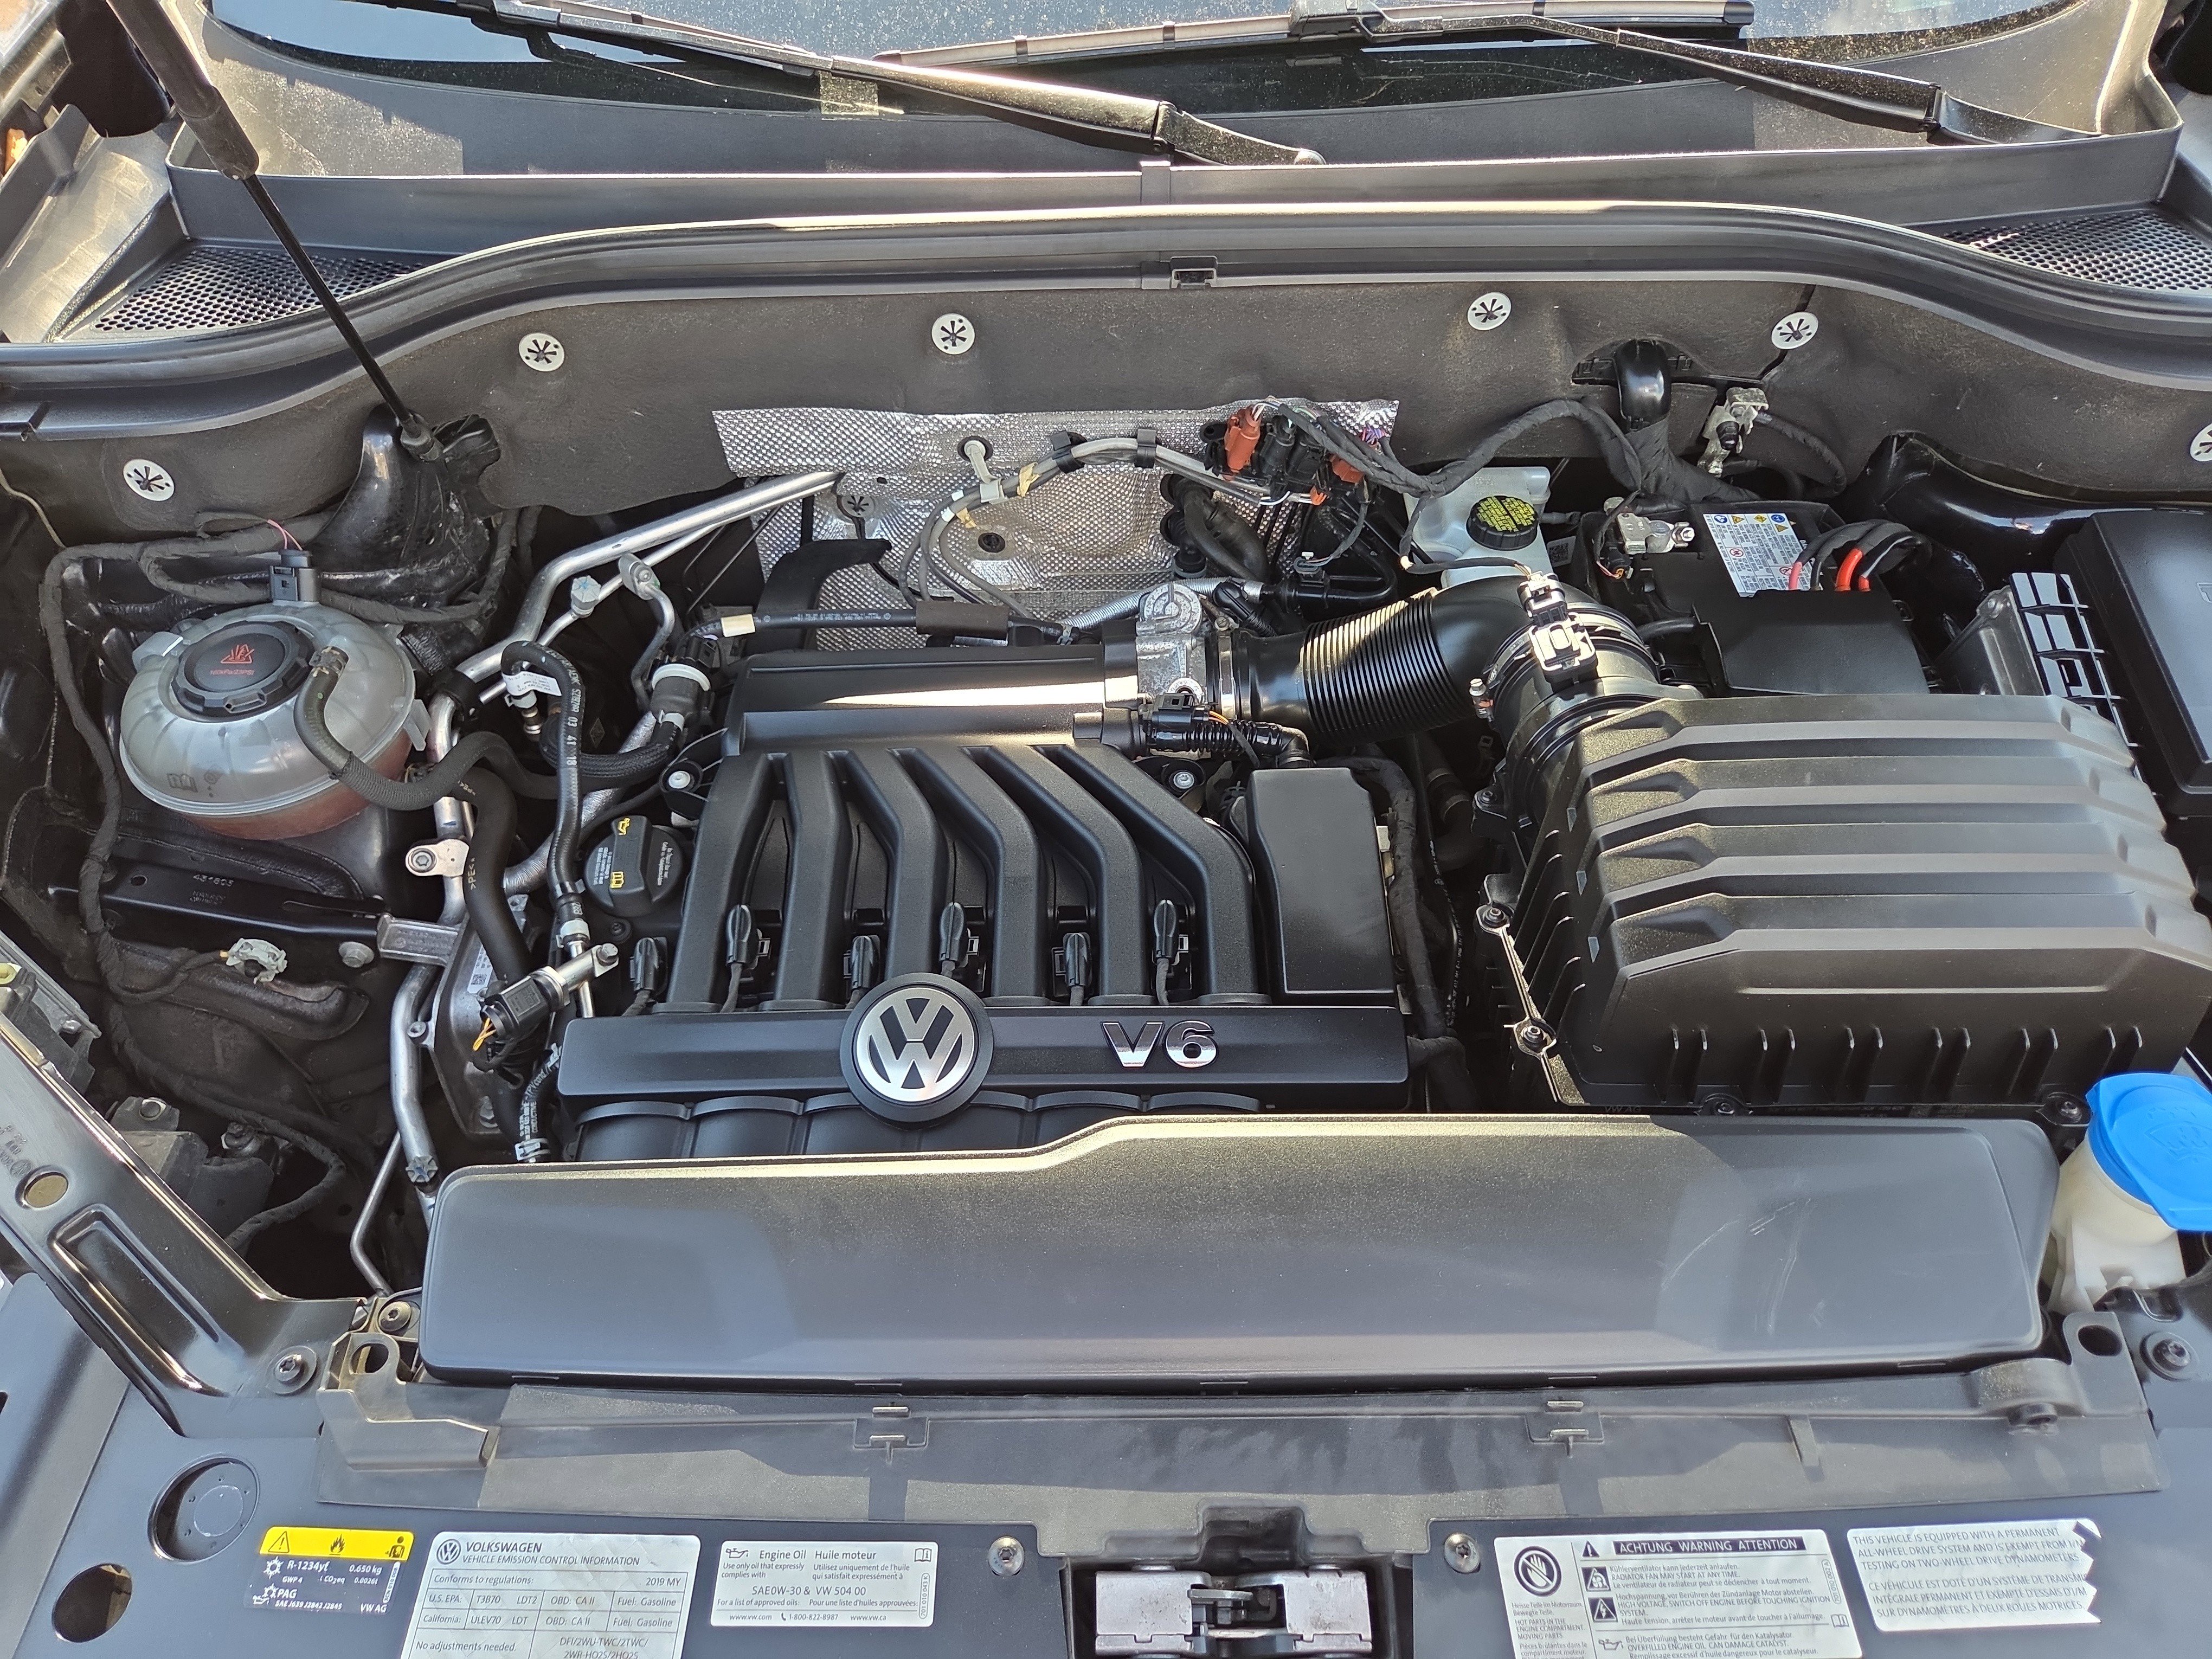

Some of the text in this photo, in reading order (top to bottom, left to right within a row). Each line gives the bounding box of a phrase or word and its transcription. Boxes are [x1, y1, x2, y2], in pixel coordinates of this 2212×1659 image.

[857, 987, 975, 1102] VW
[1101, 1020, 1219, 1069] V6
[1853, 1527, 2059, 1544] THIS VEHICLE IS EQUIPPED WITH A PERMANENT
[466, 1542, 542, 1552] VOLKSWAGEN
[1620, 1539, 1797, 1552] ACHTUNG WARNING ATTENTION
[1859, 1547, 1907, 1557] ALL-WHEEL
[1908, 1546, 1935, 1554] DRIVE
[1937, 1544, 1971, 1553] SYSTEM
[1973, 1544, 1993, 1552] AND
[1994, 1542, 2004, 1551] IS
[2004, 1541, 2039, 1551] EXEMPT
[2041, 1540, 2067, 1548] FROM
[436, 1539, 461, 1565] VW
[760, 1549, 806, 1561] Engine Oil
[815, 1549, 876, 1559] Huile moteur
[463, 1555, 494, 1563] VEHICLE
[539, 1555, 577, 1564] CONTROL
[581, 1556, 639, 1565] INFORMATION
[1861, 1560, 1899, 1570] TESTING
[1901, 1560, 1915, 1568] ON
[1917, 1557, 1974, 1567] TWO-WHEEL
[1976, 1556, 2003, 1564] DRIVE
[349, 1564, 382, 1575] 0.650 kg
[736, 1562, 750, 1572] only
[775, 1562, 804, 1571] expressly
[839, 1564, 879, 1573] uniquement
[1680, 1564, 1708, 1573] jederzeit
[434, 1574, 533, 1585] Conforms to regulations:
[721, 1571, 749, 1579] complies
[812, 1572, 822, 1581] qui
[852, 1572, 897, 1580] expressément
[646, 1577, 680, 1586] 2019 MY
[277, 1589, 297, 1598] PAG
[752, 1586, 866, 1595] SAE0W-30 & VW 504 00
[429, 1594, 676, 1606] U.S. EPA: T3B70 LDT2 OBD: CA II Fuel: Gasoline
[754, 1598, 785, 1607] approved
[1636, 1599, 1668, 1607] VOLTAGE,
[1736, 1597, 1761, 1605] BEFORE
[361, 1603, 387, 1612] VW AG
[423, 1615, 672, 1626] California: ULEV70 LDT OBD: CA II Fuel: Gasoline
[416, 1641, 515, 1652] No adjustments needed.
